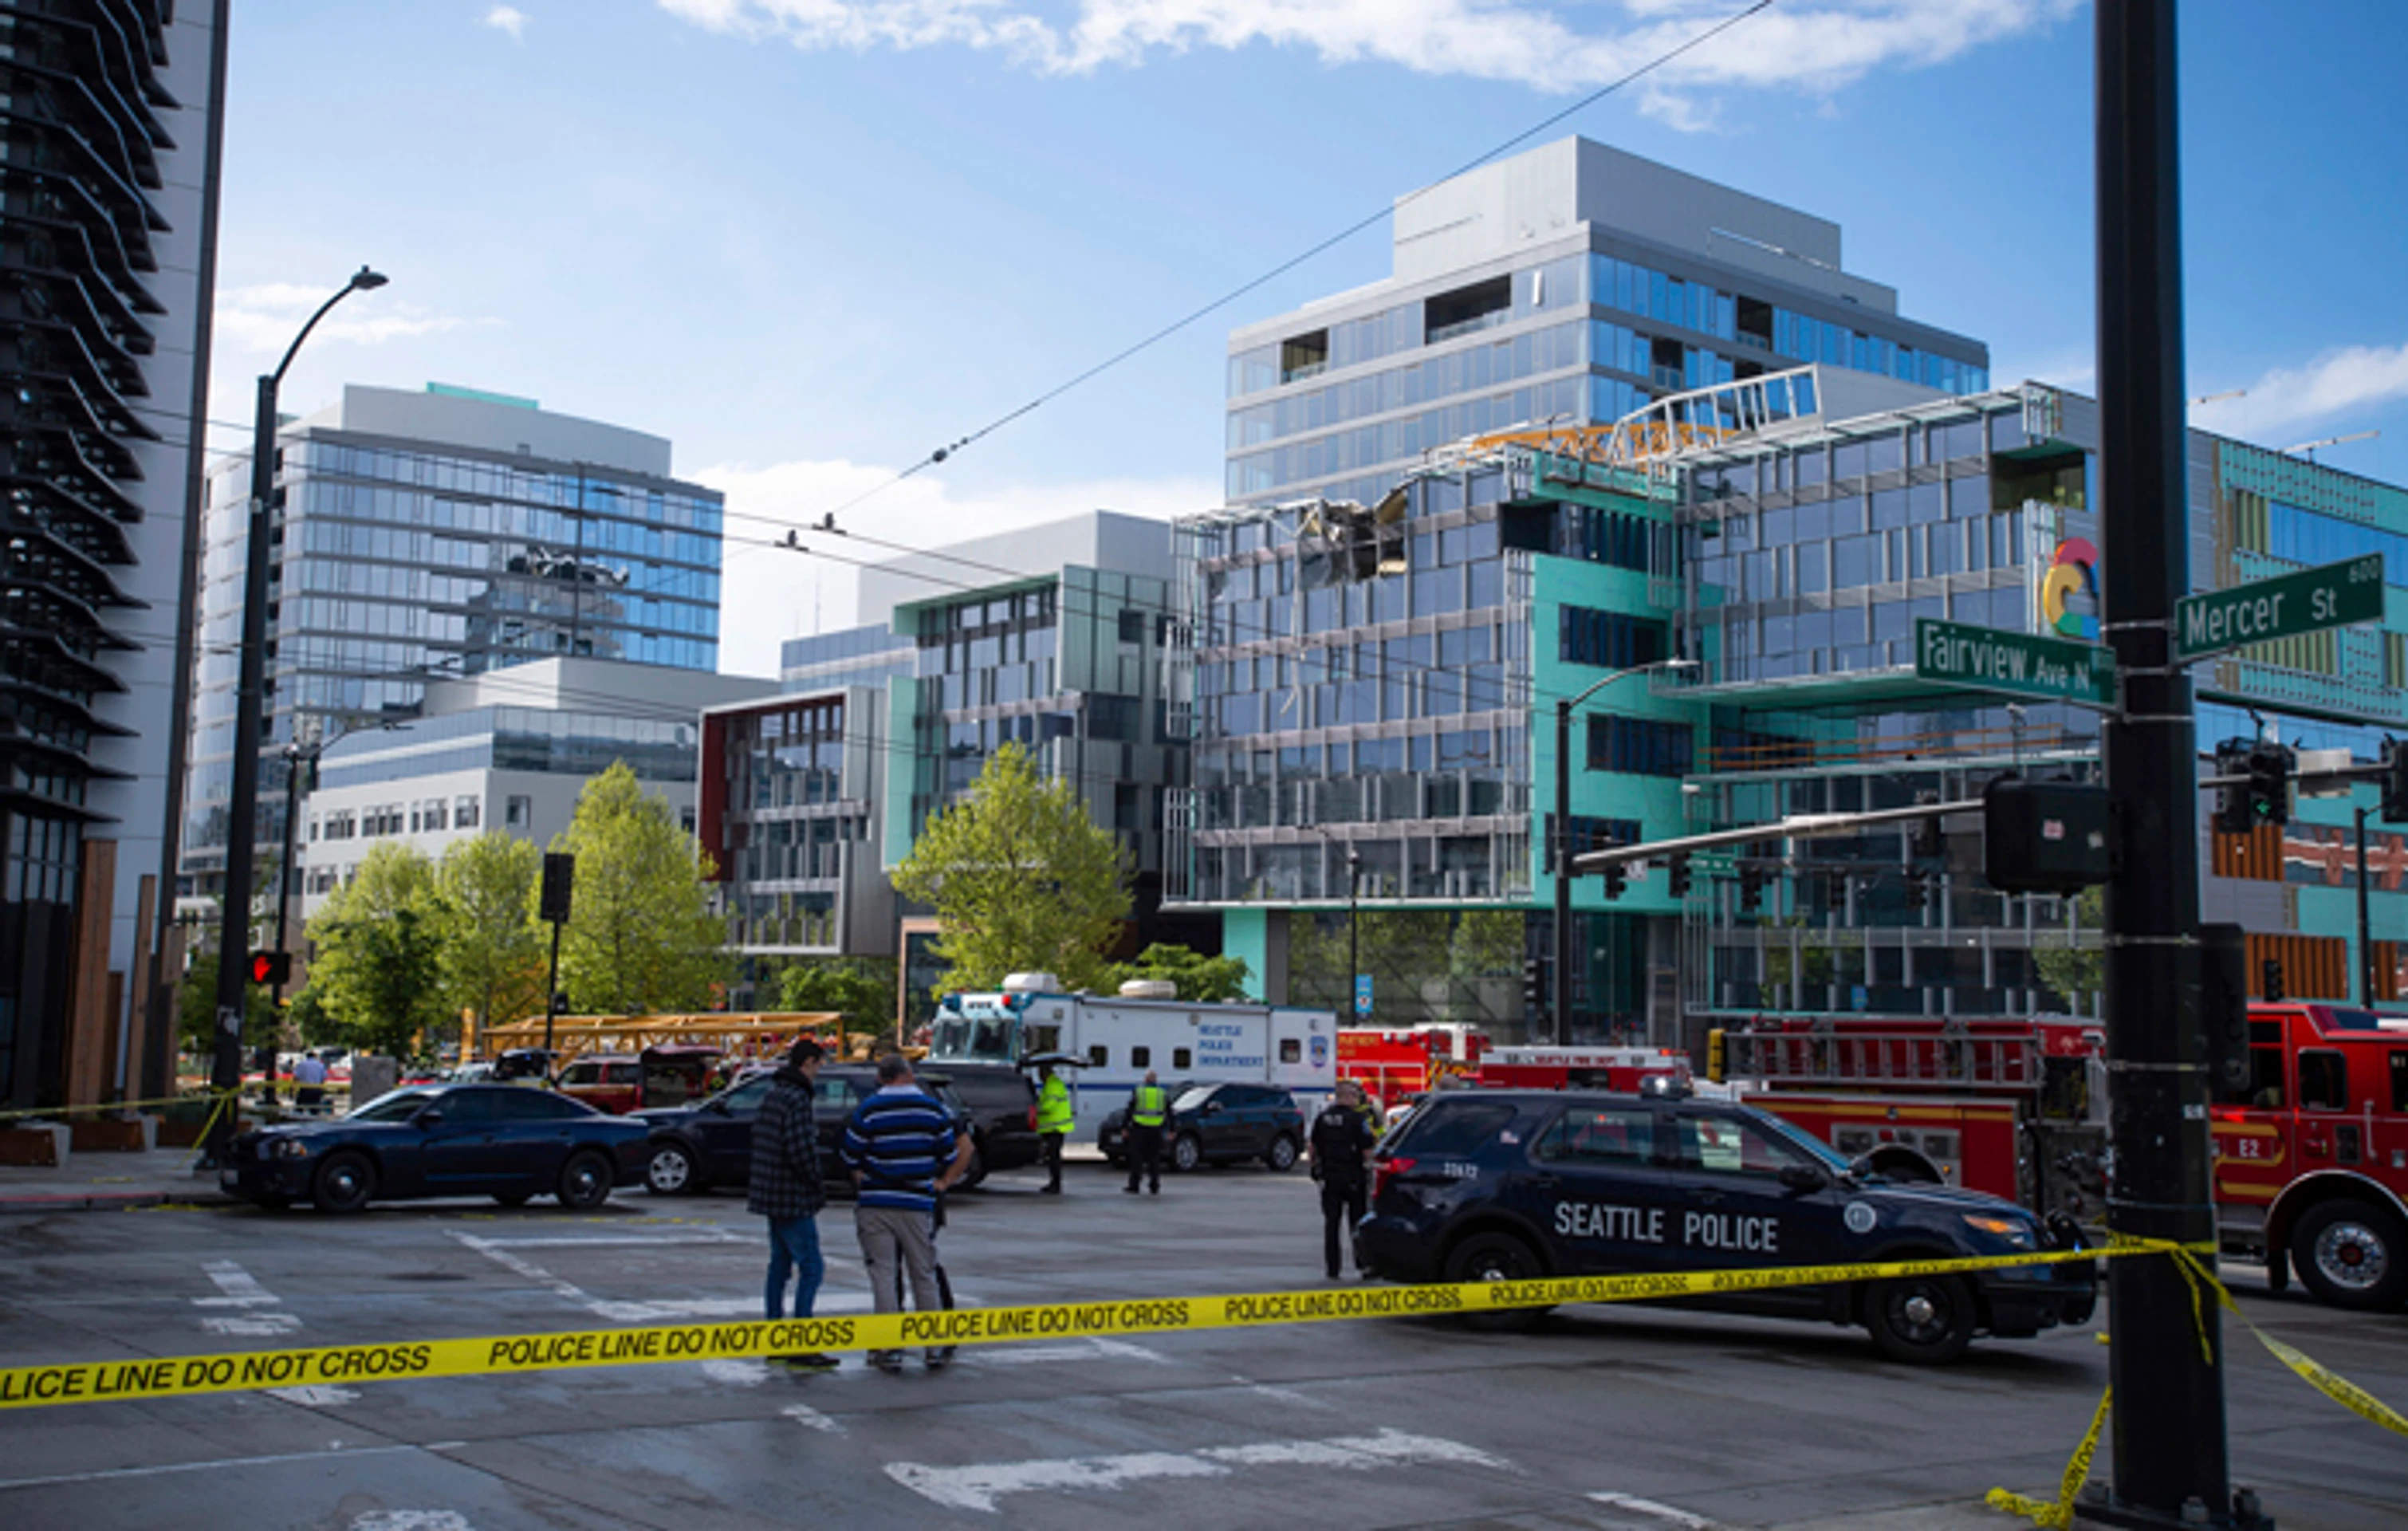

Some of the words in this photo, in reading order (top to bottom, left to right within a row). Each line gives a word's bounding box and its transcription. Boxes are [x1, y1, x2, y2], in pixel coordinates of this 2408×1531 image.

[2186, 592, 2285, 647] Mercer
[2312, 587, 2337, 620] St
[1922, 623, 2028, 682] Fairview
[2034, 655, 2068, 689] Ave
[2074, 661, 2090, 692] N
[2238, 1138, 2260, 1159] E2
[1554, 1200, 1666, 1244] SEATTLE
[1684, 1210, 1780, 1254] POLICE
[1224, 1295, 1293, 1321] POLICE
[1293, 1293, 1336, 1317] LINE
[1338, 1291, 1363, 1315] DO
[1366, 1289, 1401, 1313] NOT
[1403, 1286, 1464, 1309] CROSS
[1489, 1282, 1545, 1304] POLICE
[1637, 1275, 1689, 1293] CROSS
[488, 1334, 596, 1366] POLICE
[598, 1330, 662, 1360] LINE
[664, 1328, 706, 1354] DO
[710, 1324, 767, 1352] NOT
[768, 1320, 856, 1349] CROSS
[900, 1313, 983, 1340] POLICE
[986, 1310, 1035, 1336] LINE
[1038, 1308, 1070, 1332] DO
[1073, 1305, 1119, 1330] NOT
[1119, 1301, 1190, 1328] CROSS
[92, 1361, 176, 1395] LINE
[182, 1359, 234, 1387] DO
[240, 1352, 318, 1383] NOT
[318, 1344, 432, 1377] CROSS
